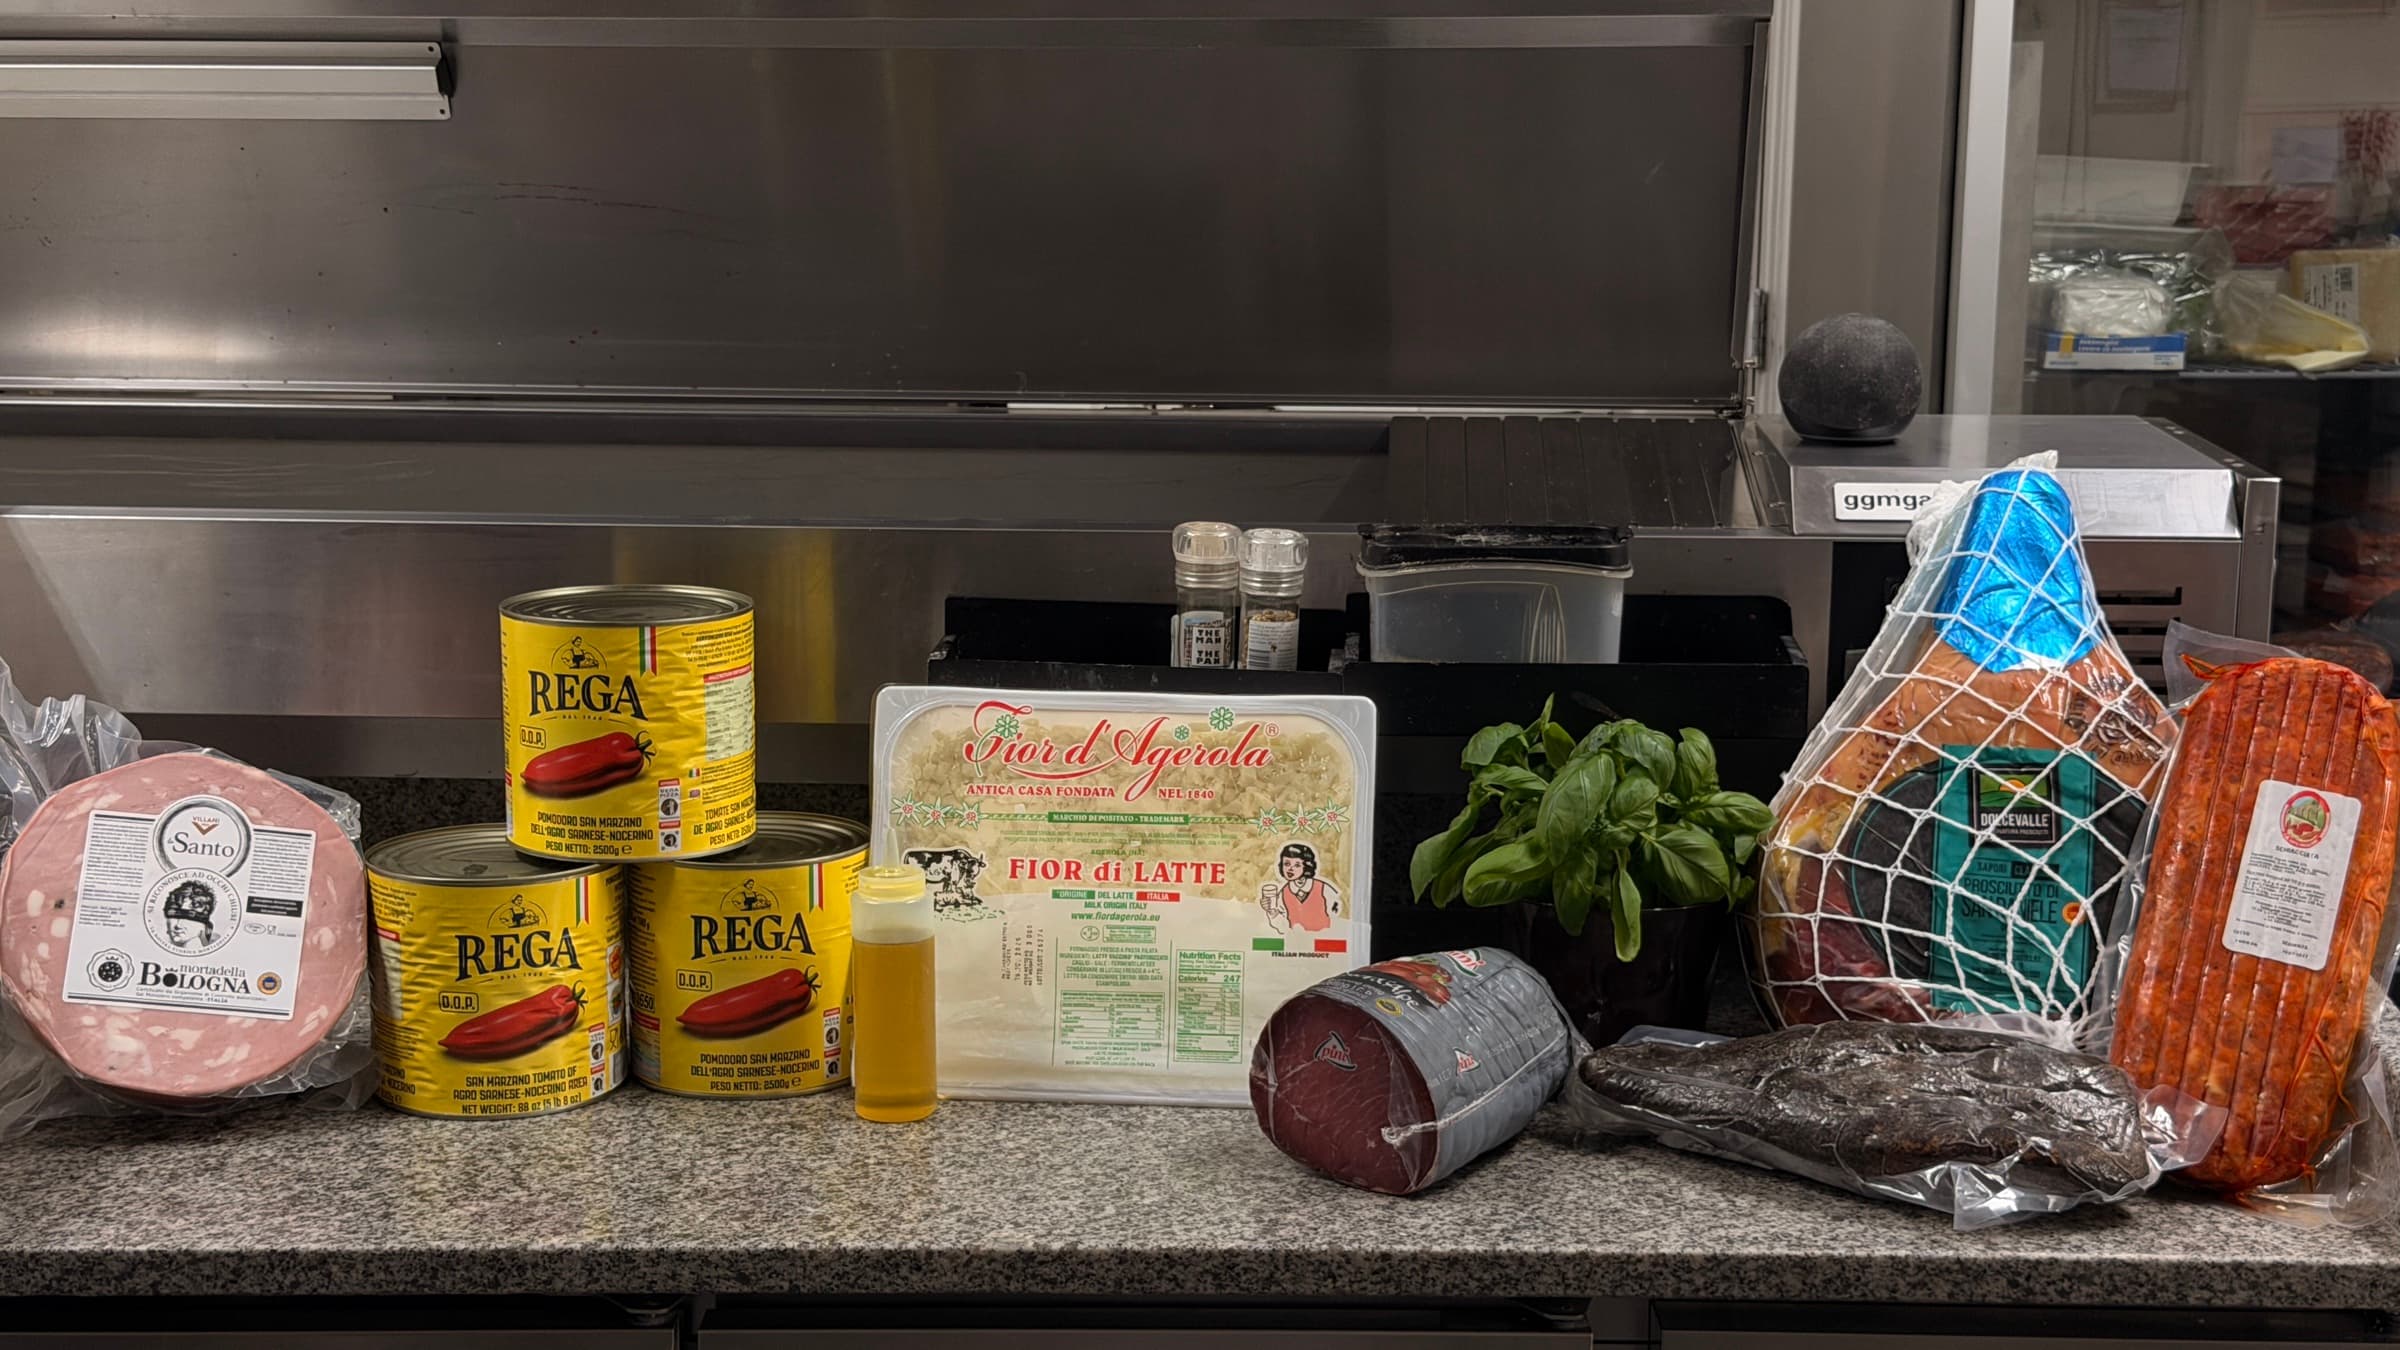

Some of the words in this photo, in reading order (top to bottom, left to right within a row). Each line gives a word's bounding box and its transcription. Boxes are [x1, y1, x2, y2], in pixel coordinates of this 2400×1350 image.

[1197, 629, 1220, 637] THE
[528, 670, 649, 722] REGA
[521, 729, 544, 746] D.O.P.
[963, 700, 1057, 766] Fior
[966, 785, 1014, 796] ANTICA
[1018, 785, 1052, 797] CASA
[1056, 786, 1115, 798] FONDATA
[1158, 788, 1182, 798] NEL
[1185, 788, 1214, 799] 1840
[538, 811, 578, 827] POMODORO
[579, 817, 597, 828] SAN
[600, 817, 642, 828] MARZANO
[705, 805, 729, 820] TOMATE
[1053, 813, 1087, 822] MARCHIO
[1088, 814, 1134, 823] DEPOSITATO
[1139, 815, 1185, 823] TRADEMARK
[531, 823, 566, 839] DELL'AGRO
[568, 829, 654, 841] SARNESE-NOCERINO
[693, 824, 704, 835] DE
[705, 820, 723, 833] AGRO
[172, 832, 235, 858] Santo
[709, 833, 726, 845] PESO
[546, 840, 563, 851] PESO
[565, 843, 591, 854] NETTO:
[593, 845, 619, 856] 2500g
[1009, 858, 1083, 881] FIOR
[1094, 861, 1122, 882] di
[1134, 862, 1226, 884] LATTE
[150, 871, 188, 904] RICONOSCE
[192, 871, 205, 879] AD
[206, 873, 231, 894] OCCHI
[2046, 885, 2059, 898] DI
[1097, 891, 1110, 899] DEL
[1111, 892, 1134, 900] LATTE
[1146, 892, 1169, 901] ITALIA
[1084, 901, 1102, 909] MILK
[1103, 901, 1127, 909] ORIGIN
[1128, 902, 1148, 910] ITALY
[1071, 911, 1161, 922] www.fiordagerola.eu
[690, 912, 816, 960] REGA
[454, 927, 583, 982] REGA
[1179, 952, 1216, 960] Nutrition
[1218, 952, 1241, 960] Facts
[180, 964, 246, 978] mortadella
[678, 974, 709, 988] D.O.P.
[441, 994, 476, 1010] D.O.P.
[701, 1053, 748, 1064] POMODORO
[750, 1053, 768, 1064] SAN
[770, 1049, 810, 1063] MARZANO
[691, 1065, 734, 1077] DELL'AGRO
[737, 1060, 820, 1077] SARNESE-NOCERINO
[466, 1076, 484, 1087] SAN
[486, 1074, 530, 1087] MARZANO
[532, 1068, 565, 1082] TOMATO
[567, 1066, 577, 1077] OF
[453, 1089, 477, 1100] AGRO
[480, 1082, 567, 1100] SARNESE-NOCERINO
[568, 1076, 587, 1090] AREA
[710, 1081, 731, 1091] PESO
[733, 1081, 761, 1091] NETTO:
[764, 1079, 789, 1090] 2500g
[462, 1104, 478, 1114] NET
[480, 1103, 516, 1114] WEIGHT:
[518, 1102, 529, 1112] 88
